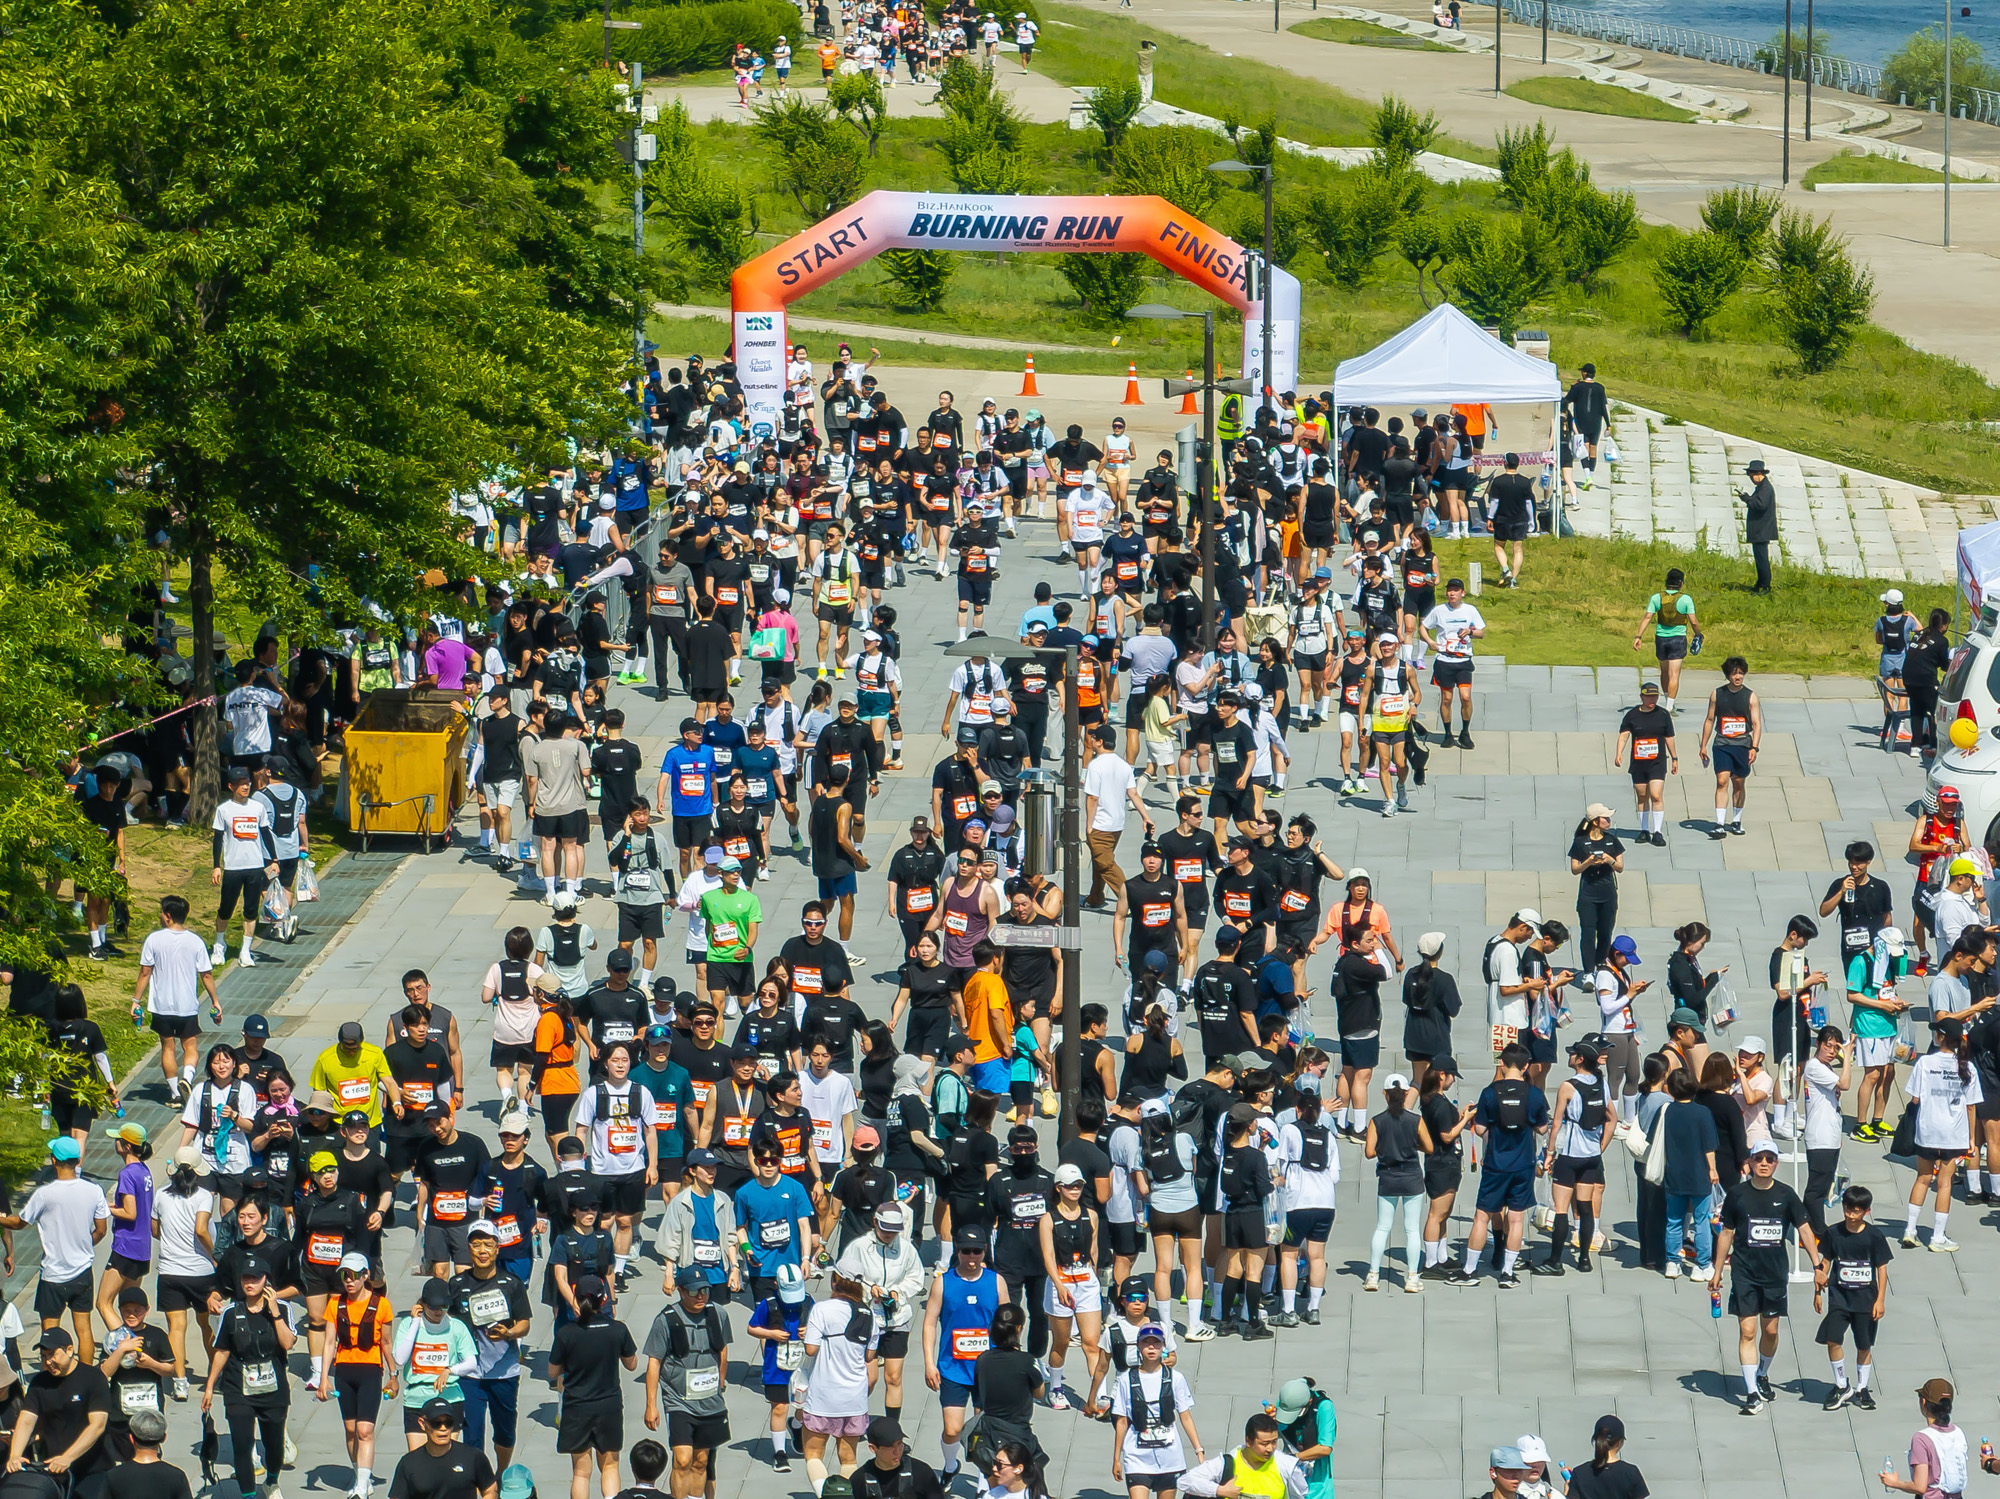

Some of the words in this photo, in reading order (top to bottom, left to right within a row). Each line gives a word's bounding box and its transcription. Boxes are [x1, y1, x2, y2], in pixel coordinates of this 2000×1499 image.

[907, 213, 1049, 241] BURNING
[1053, 216, 1124, 241] RUN
[777, 216, 868, 286] START
[1159, 220, 1247, 292] FINISH
[351, 1085, 369, 1094] 1658
[484, 1299, 505, 1310] 5232
[426, 1353, 447, 1361] 4097
